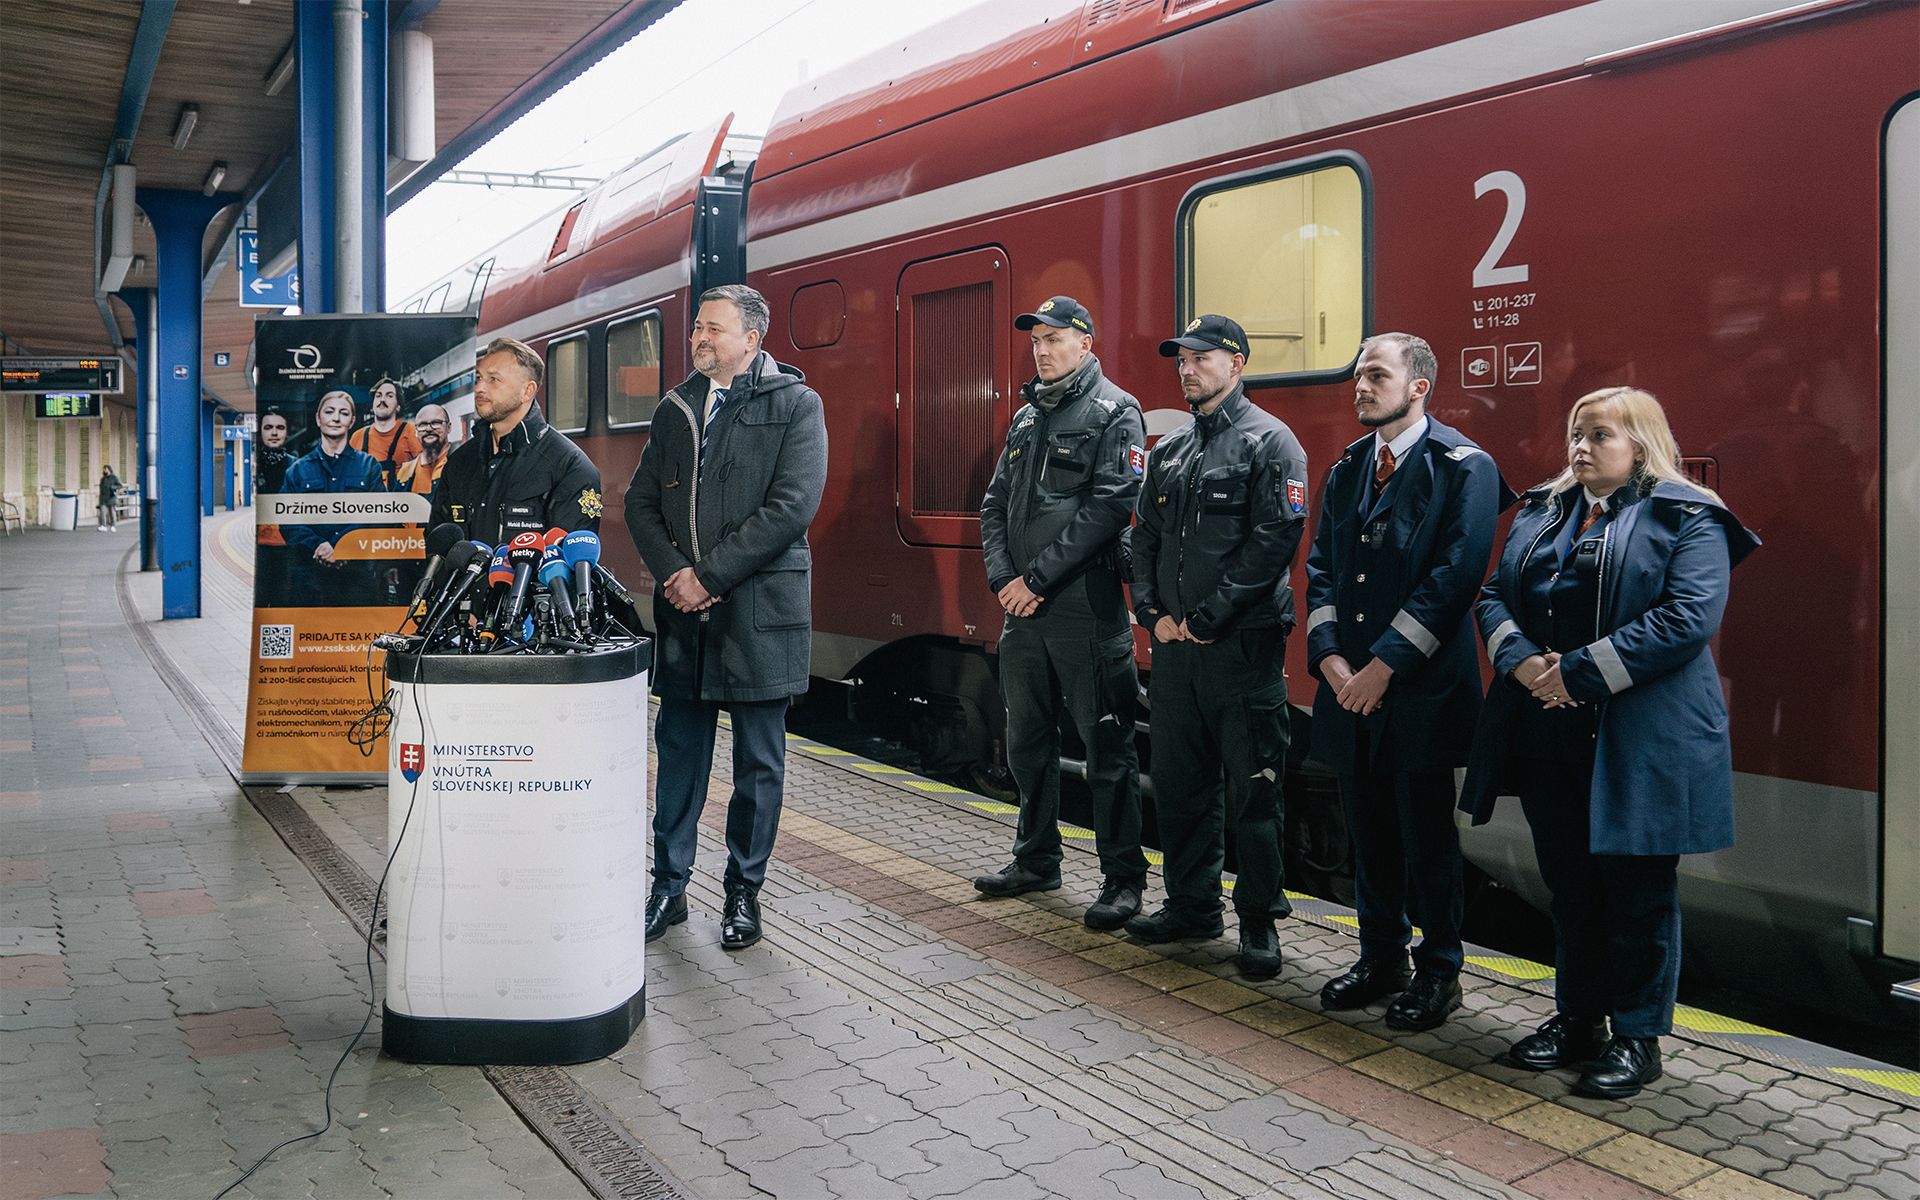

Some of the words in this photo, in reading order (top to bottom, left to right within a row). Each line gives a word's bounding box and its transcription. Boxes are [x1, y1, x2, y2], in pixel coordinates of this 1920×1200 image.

[1472, 169, 1529, 289] 2
[1487, 293, 1537, 311] 201-237
[1487, 312, 1520, 328] 11-28
[217, 354, 227, 365] B
[106, 371, 112, 387] 1
[332, 500, 410, 514] Slovensko
[358, 539, 368, 550] v
[371, 536, 427, 552] pohybe
[512, 548, 535, 558] Netky
[299, 632, 347, 641] PRIDAJTE
[349, 632, 362, 641] SA
[364, 632, 372, 641] K
[259, 665, 278, 673] Sme
[297, 664, 348, 675] profesionáli,
[290, 697, 320, 707] výhody
[321, 696, 355, 706] stabilnej
[256, 718, 342, 727] elektromechanikom,
[432, 744, 534, 756] MINISTERSTVO
[432, 763, 493, 777] VNÚTRA
[432, 780, 514, 795] SLOVENSKEJ
[518, 778, 593, 792] REPUBLIKY
